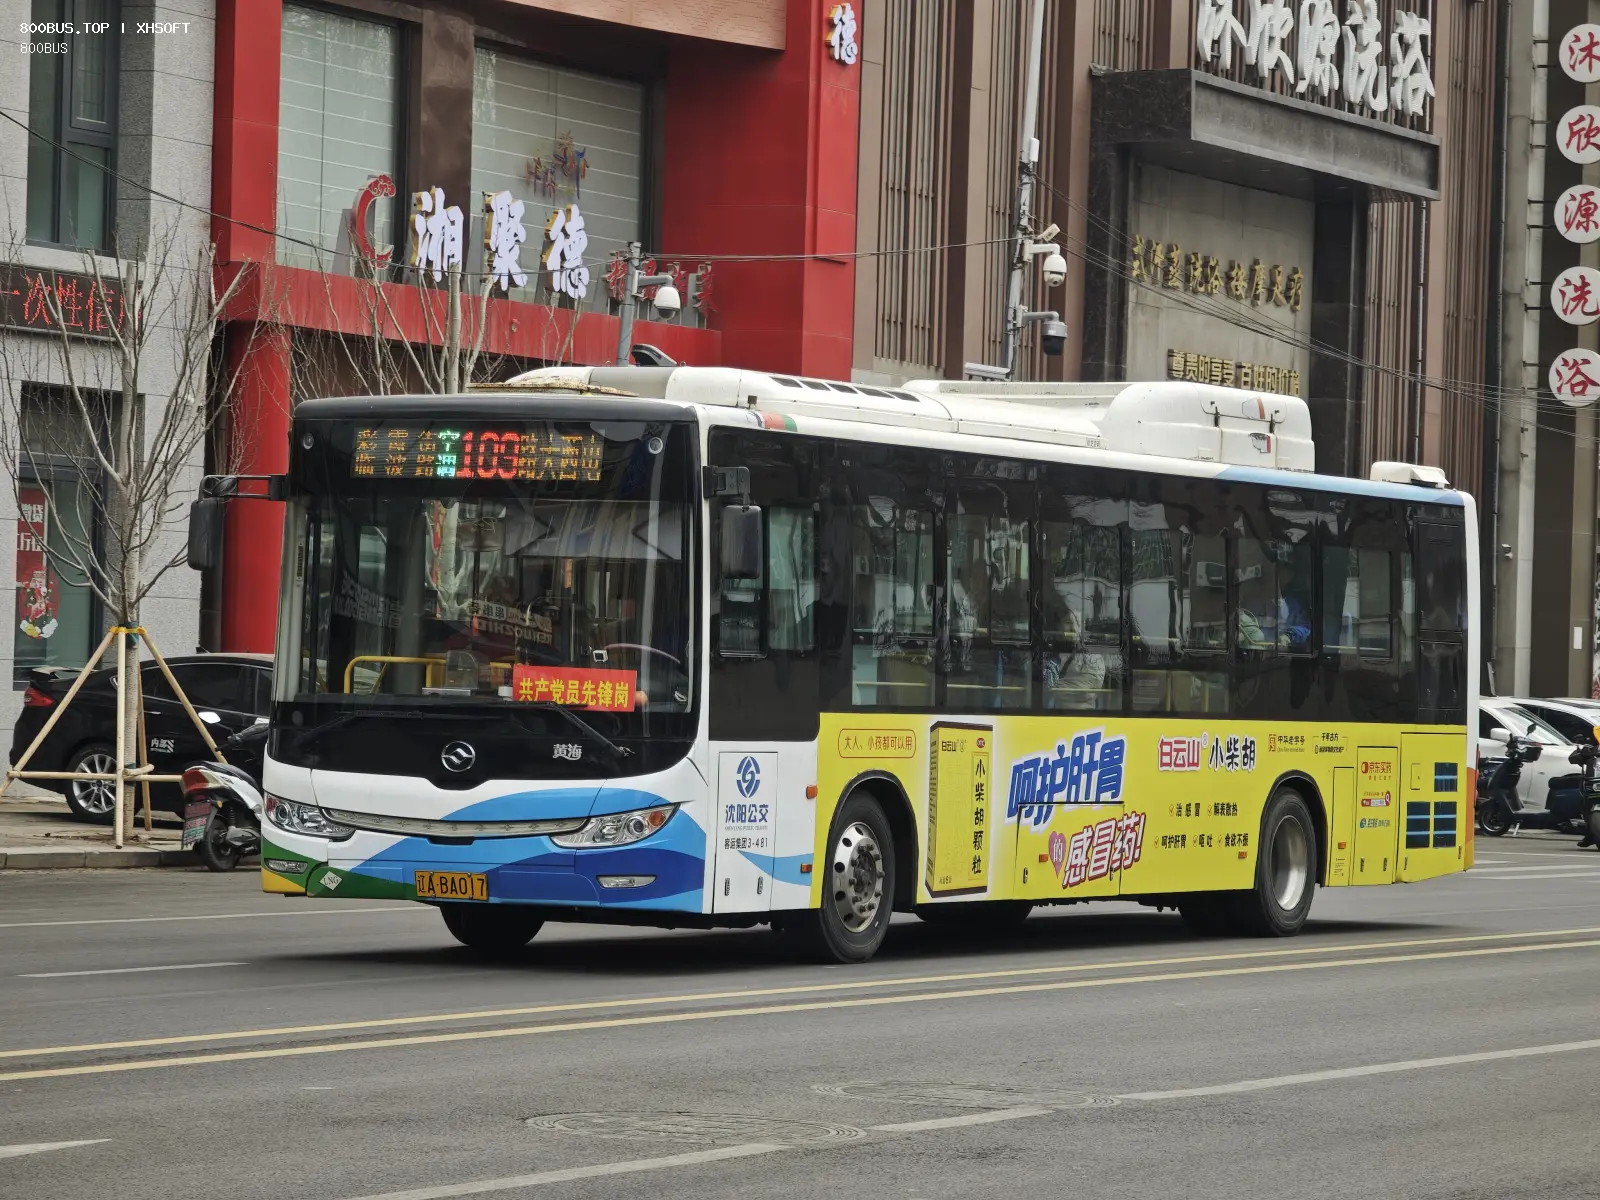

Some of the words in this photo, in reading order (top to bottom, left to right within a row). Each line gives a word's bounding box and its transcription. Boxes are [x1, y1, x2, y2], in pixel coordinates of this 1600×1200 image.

[825, 3, 858, 65] 德
[1555, 31, 1600, 397] 沐欣源洗浴
[411, 185, 590, 299] 湘聚德
[1171, 349, 1236, 388] 尊贵的享受
[456, 431, 521, 479] 109
[518, 677, 629, 709] 共产党员先锋岗
[552, 743, 583, 760] 黄海
[844, 735, 913, 750] 大人、小孩都可以用
[1159, 738, 1200, 768] 白云山
[1209, 736, 1256, 769] 小柴胡
[1006, 731, 1125, 826] 呵护肝胃
[724, 803, 769, 823] 沈阳公交
[971, 758, 986, 875] 小柴胡颗粒
[323, 876, 339, 885] LNG
